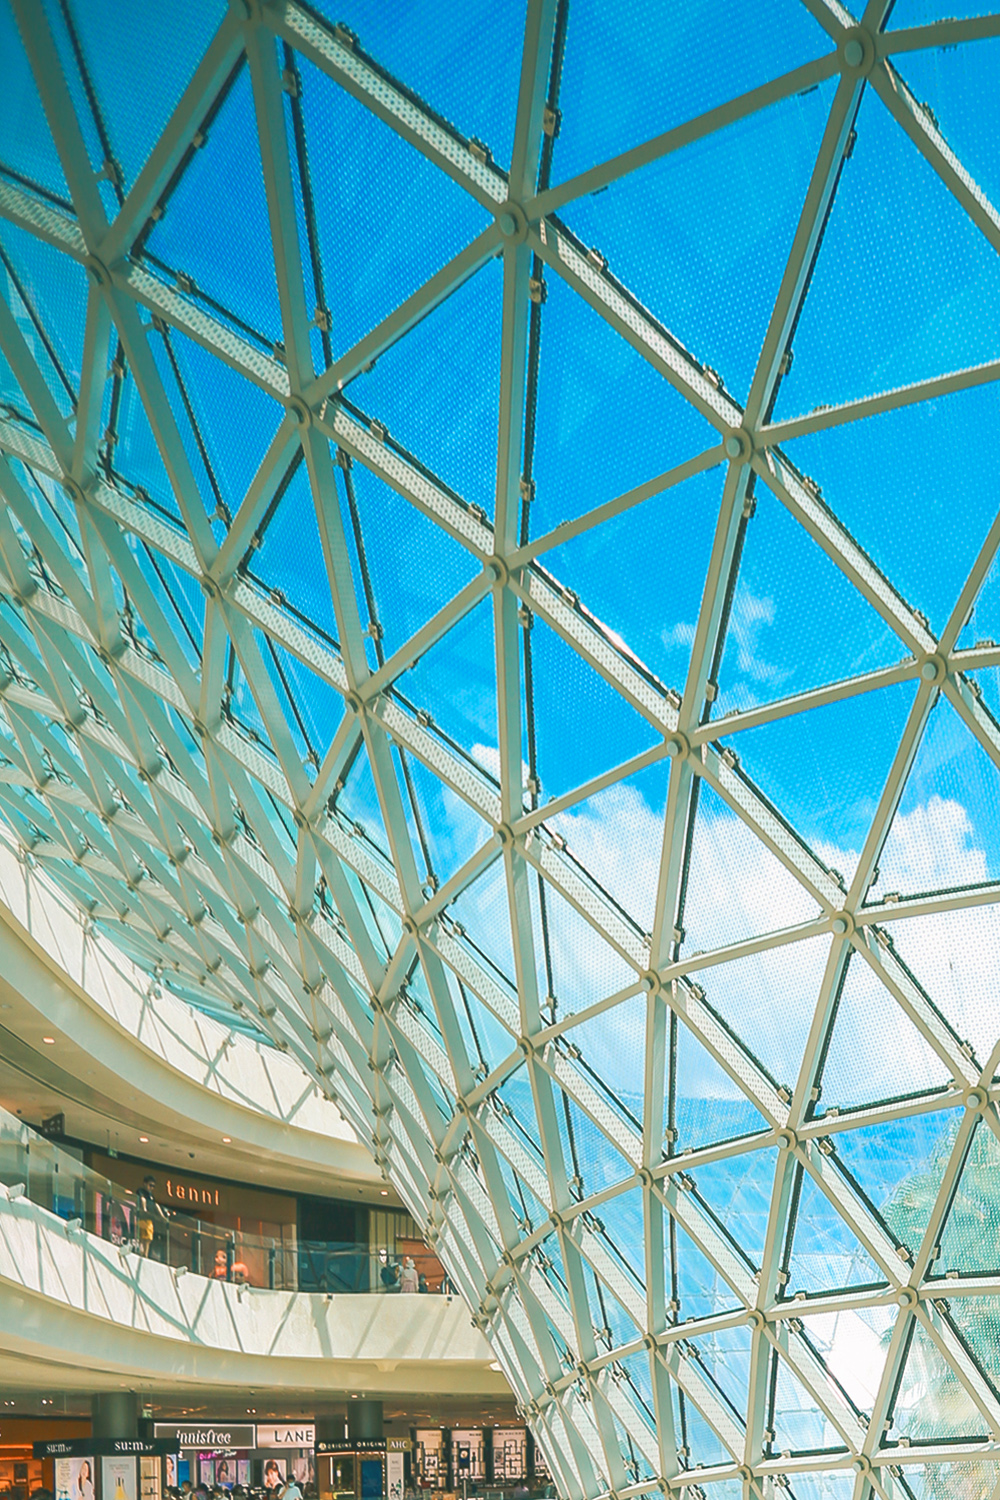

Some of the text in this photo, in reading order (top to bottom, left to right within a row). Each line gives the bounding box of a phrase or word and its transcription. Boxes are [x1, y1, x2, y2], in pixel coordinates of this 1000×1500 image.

[166, 1179, 220, 1206] tanni
[176, 1429, 231, 1444] innisfree
[274, 1430, 314, 1443] LANE
[356, 1440, 386, 1448] ORIGINS
[390, 1439, 408, 1449] AHC
